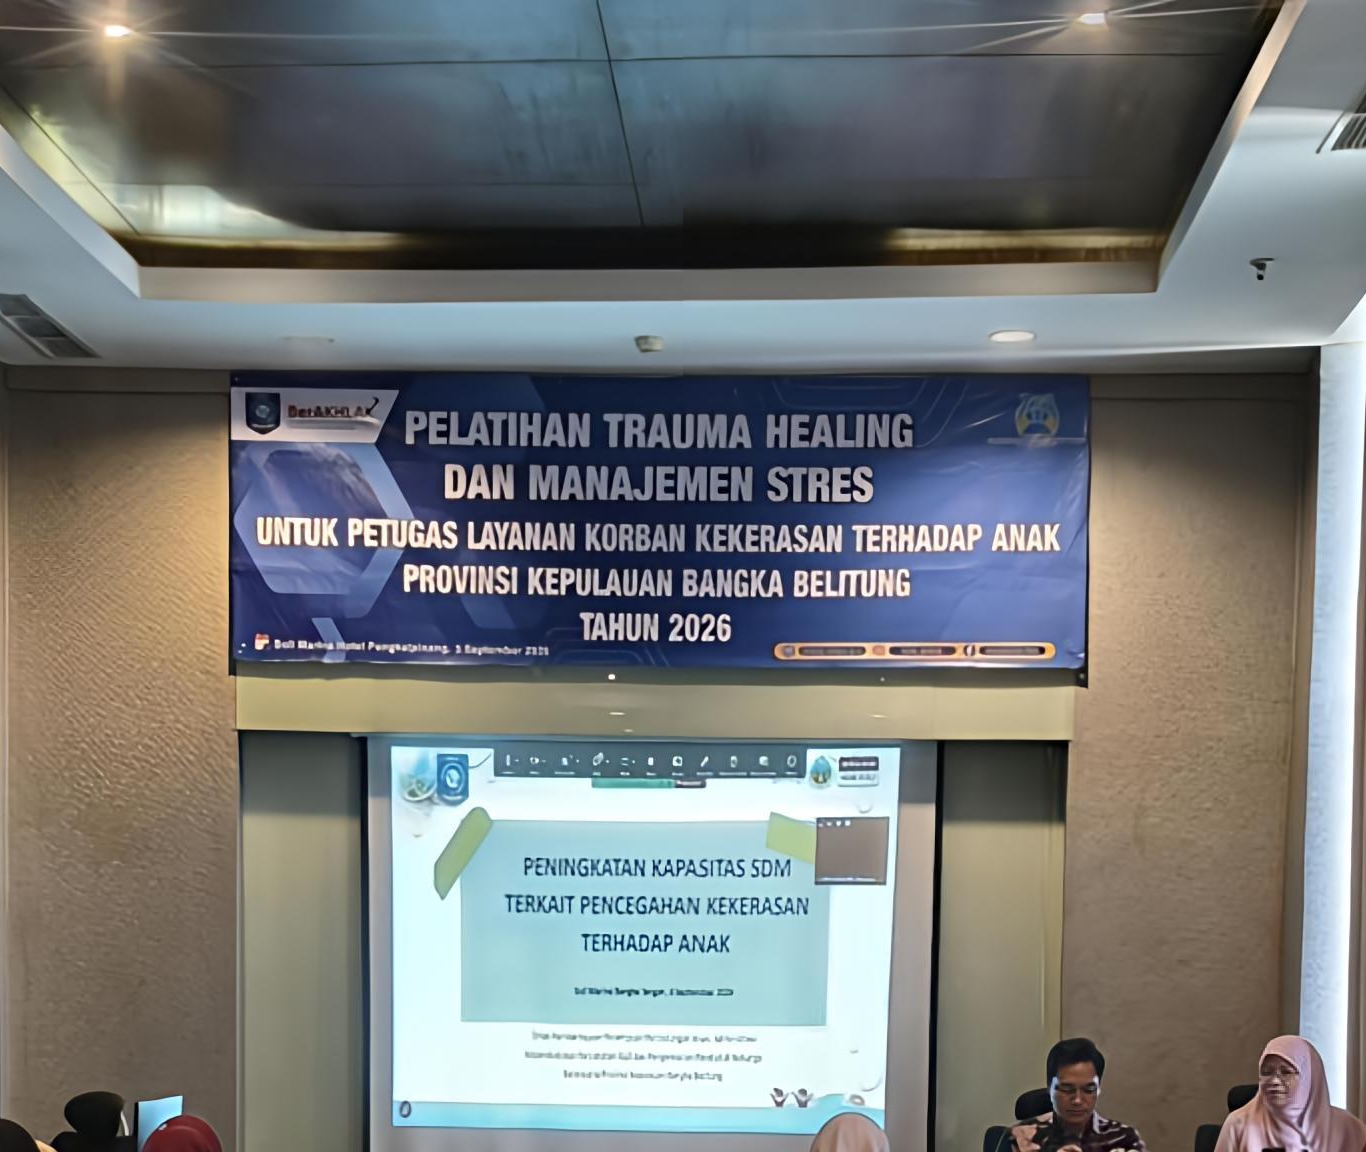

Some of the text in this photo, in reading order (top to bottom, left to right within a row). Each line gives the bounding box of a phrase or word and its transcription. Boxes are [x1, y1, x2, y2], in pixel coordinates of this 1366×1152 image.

[404, 410, 914, 450] PELATIHAN TRAUMA HEALING
[444, 463, 874, 503] DAN MANAJEMEN STRES
[256, 516, 1061, 553] UNTUK PETUGAS LAYANAN KORBAN KEKERASAN TERHADAP ANAK
[402, 563, 911, 598] PROVINSI KEPULAUAN BANGKA BELITUNG
[579, 611, 732, 643] TAHUN 2026
[523, 856, 792, 879] PENINGKATAN KAPASITAS SDM
[504, 893, 810, 916] TERKAIT PENCEGAHAN KEKERASAN
[580, 932, 731, 954] TERHADAP ANAK
